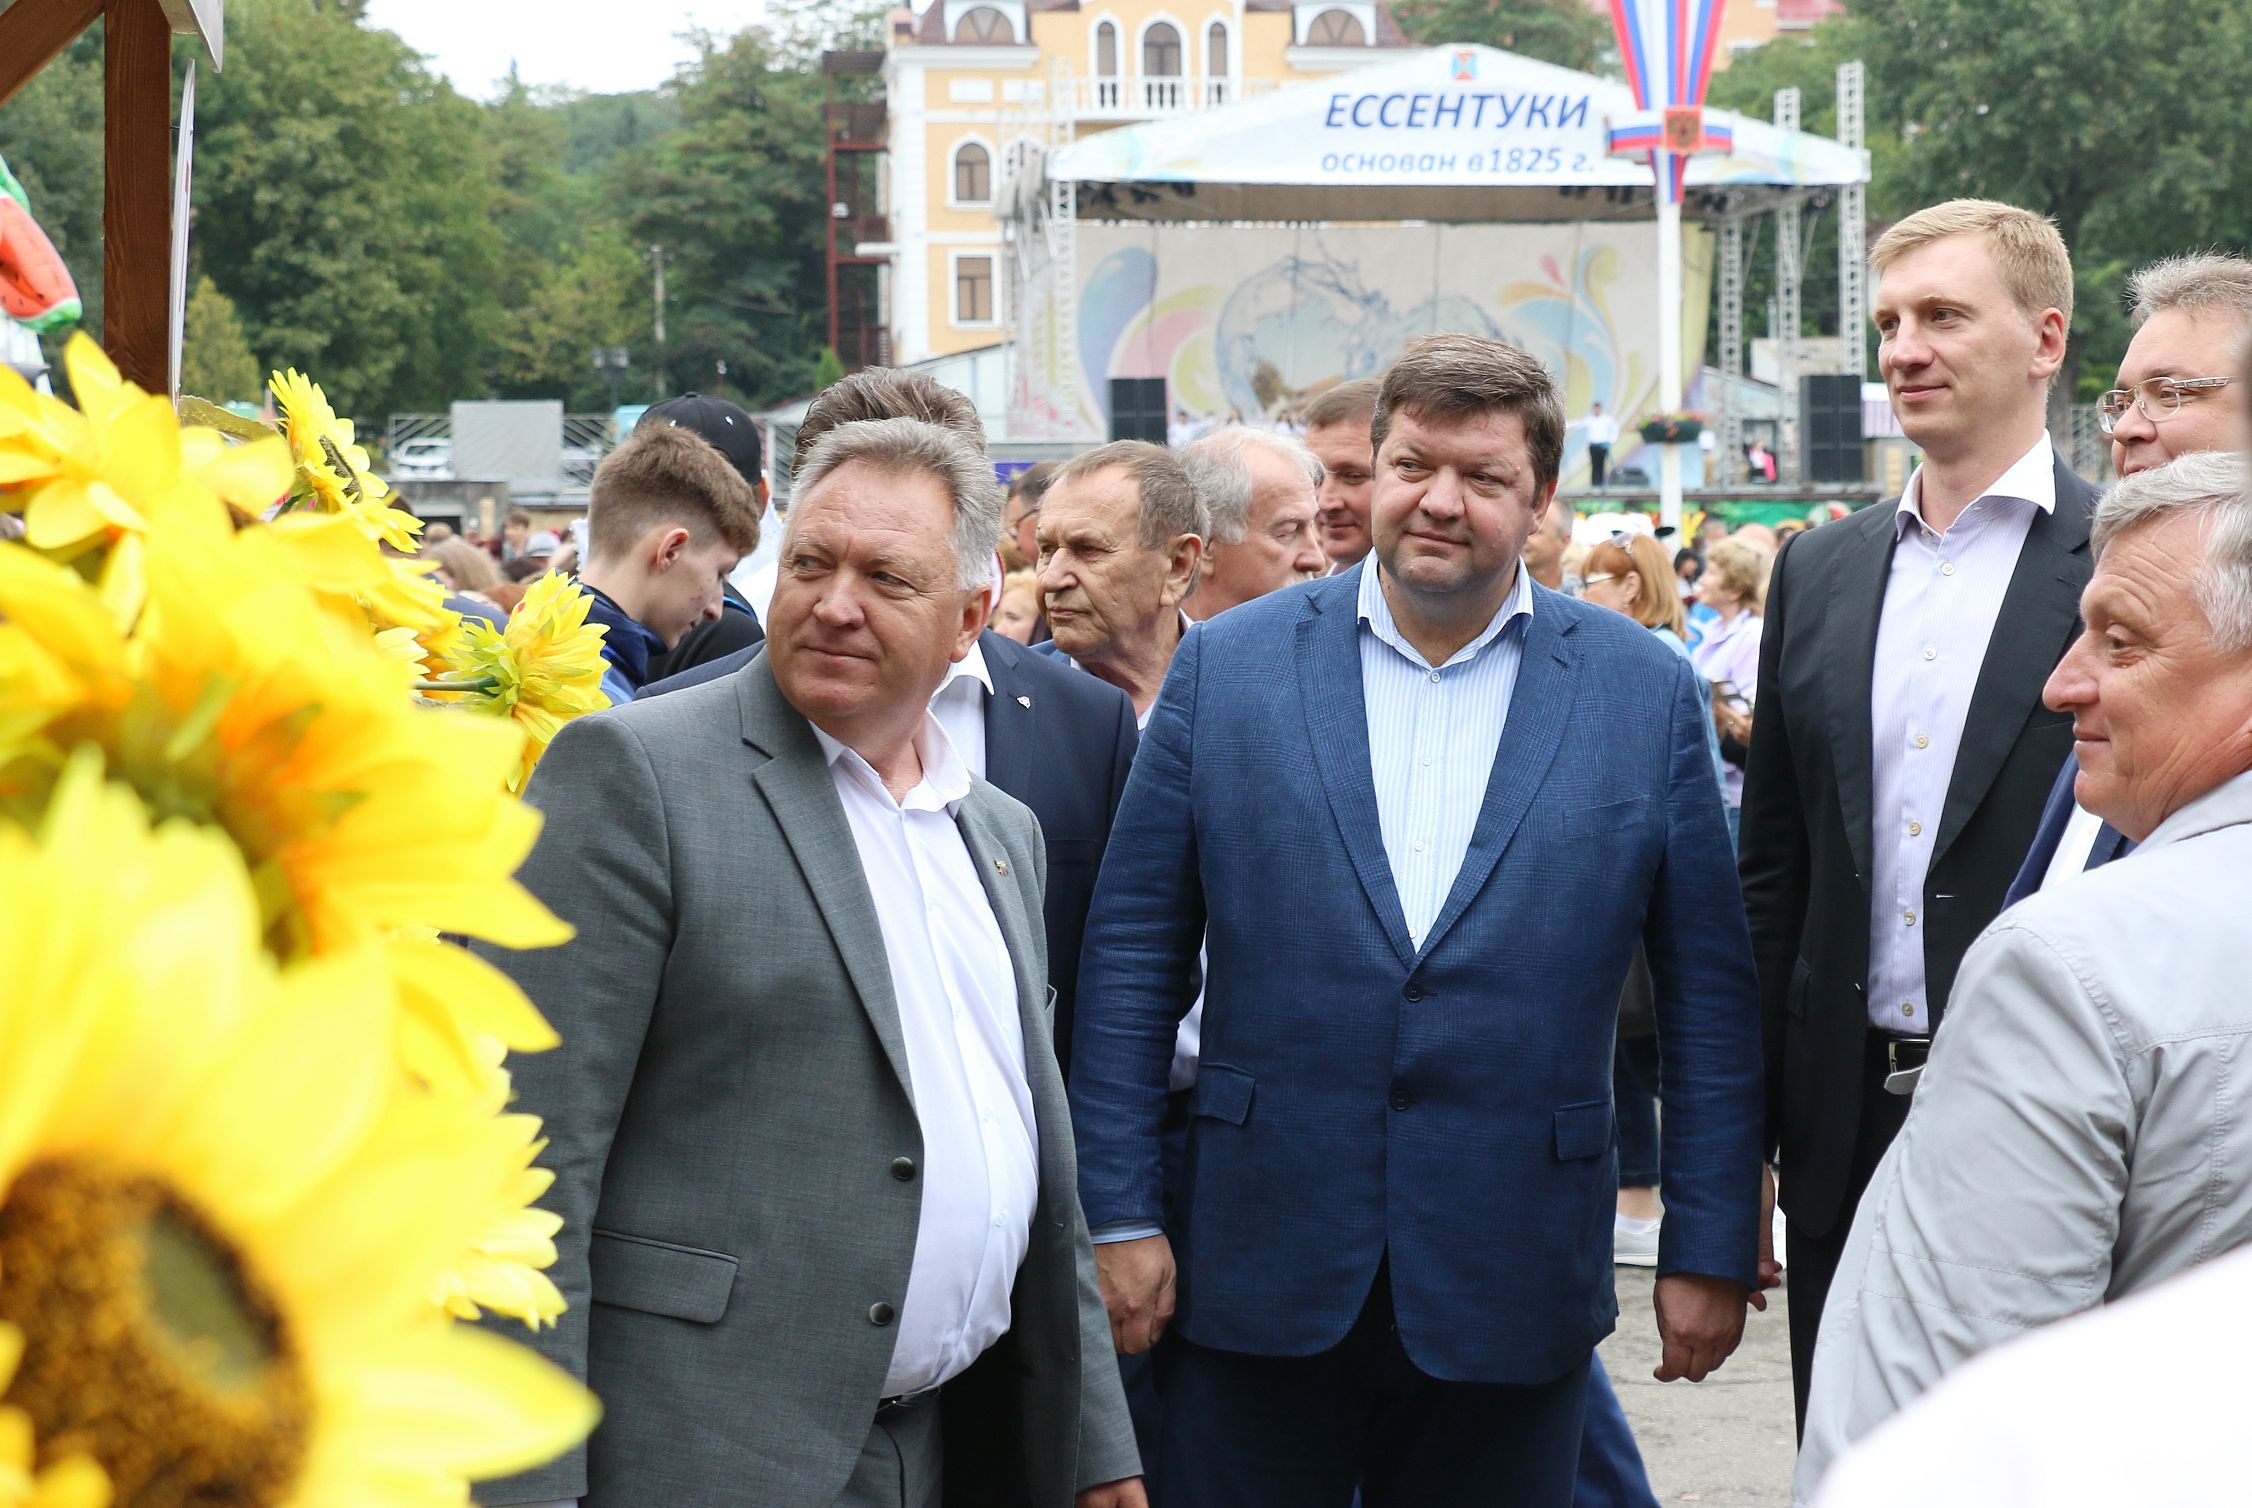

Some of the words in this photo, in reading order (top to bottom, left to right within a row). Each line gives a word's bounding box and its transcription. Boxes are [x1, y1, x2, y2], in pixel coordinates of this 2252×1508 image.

[1325, 94, 1590, 129] ЕССЕНТУКИ
[1320, 154, 1457, 174] основан
[1571, 155, 1594, 174] г.
